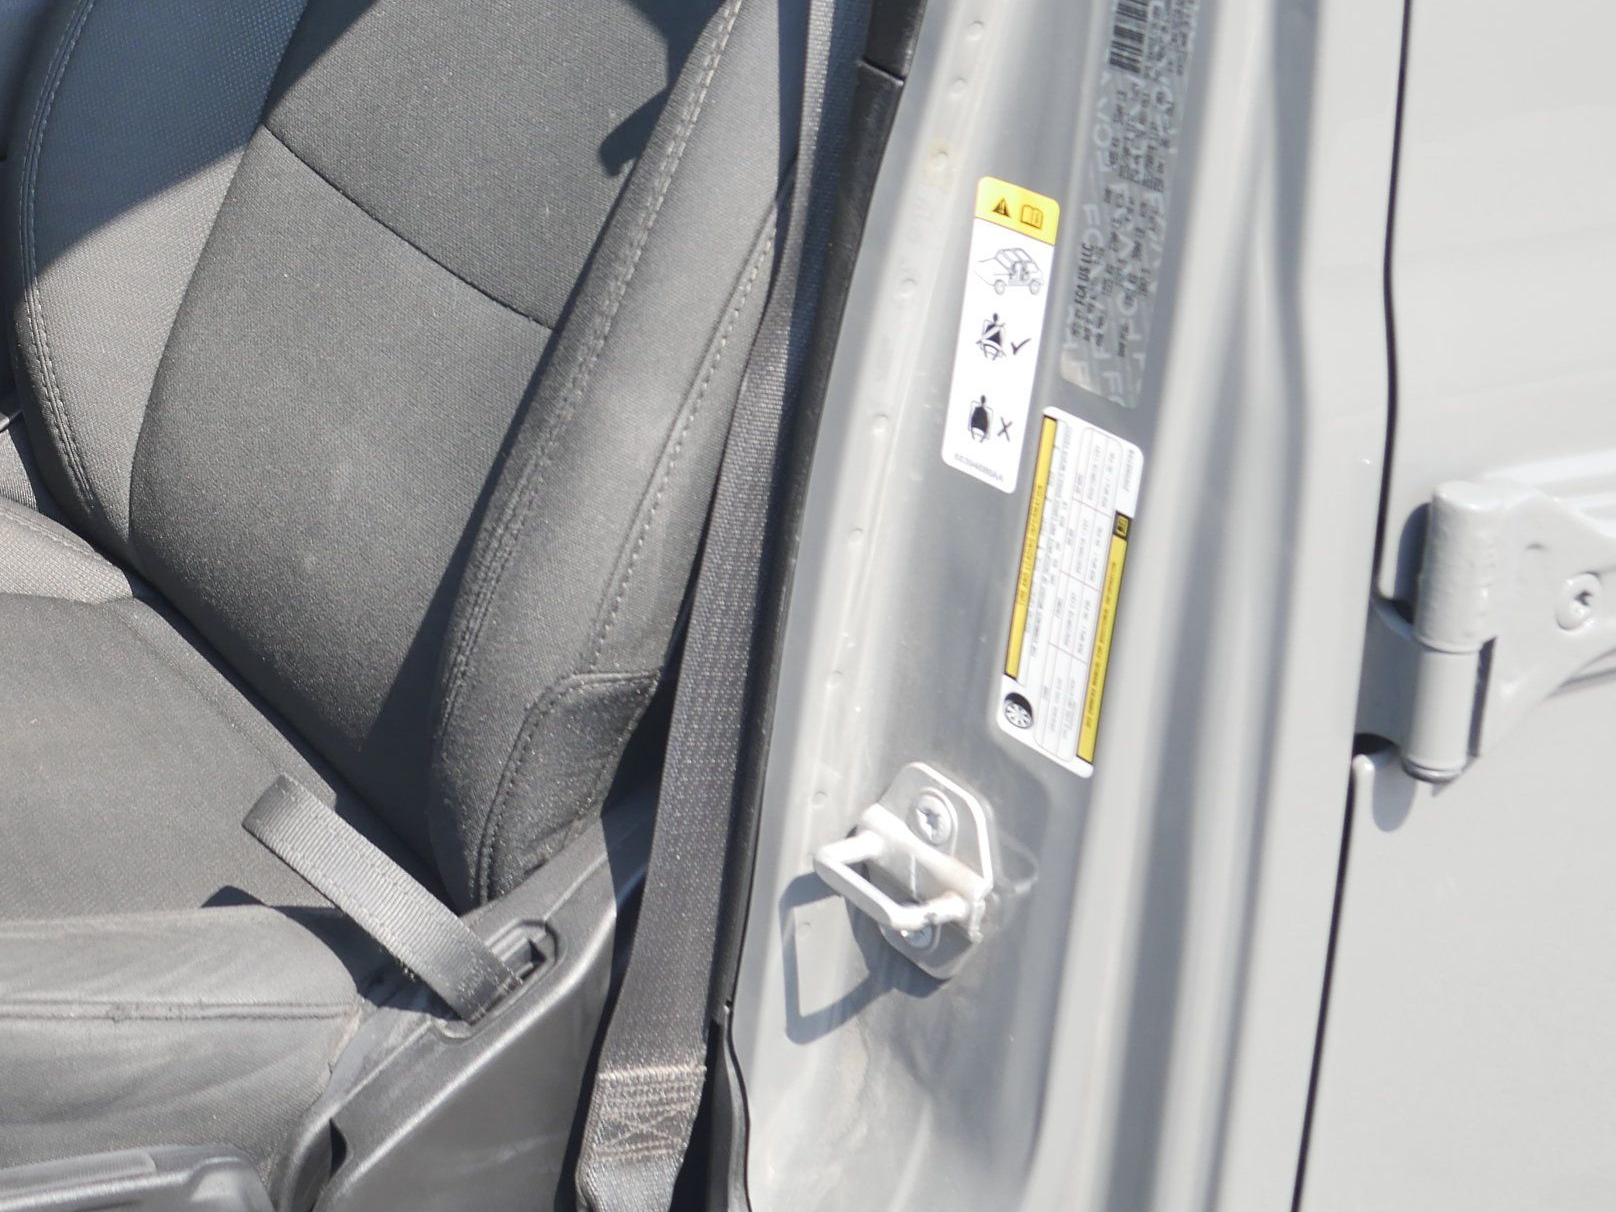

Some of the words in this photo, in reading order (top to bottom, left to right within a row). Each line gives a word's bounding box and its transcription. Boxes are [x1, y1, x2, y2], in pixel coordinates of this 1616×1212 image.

[1080, 242, 1094, 264] LLC
[1077, 265, 1091, 283] US
[1074, 284, 1087, 306] FCA
